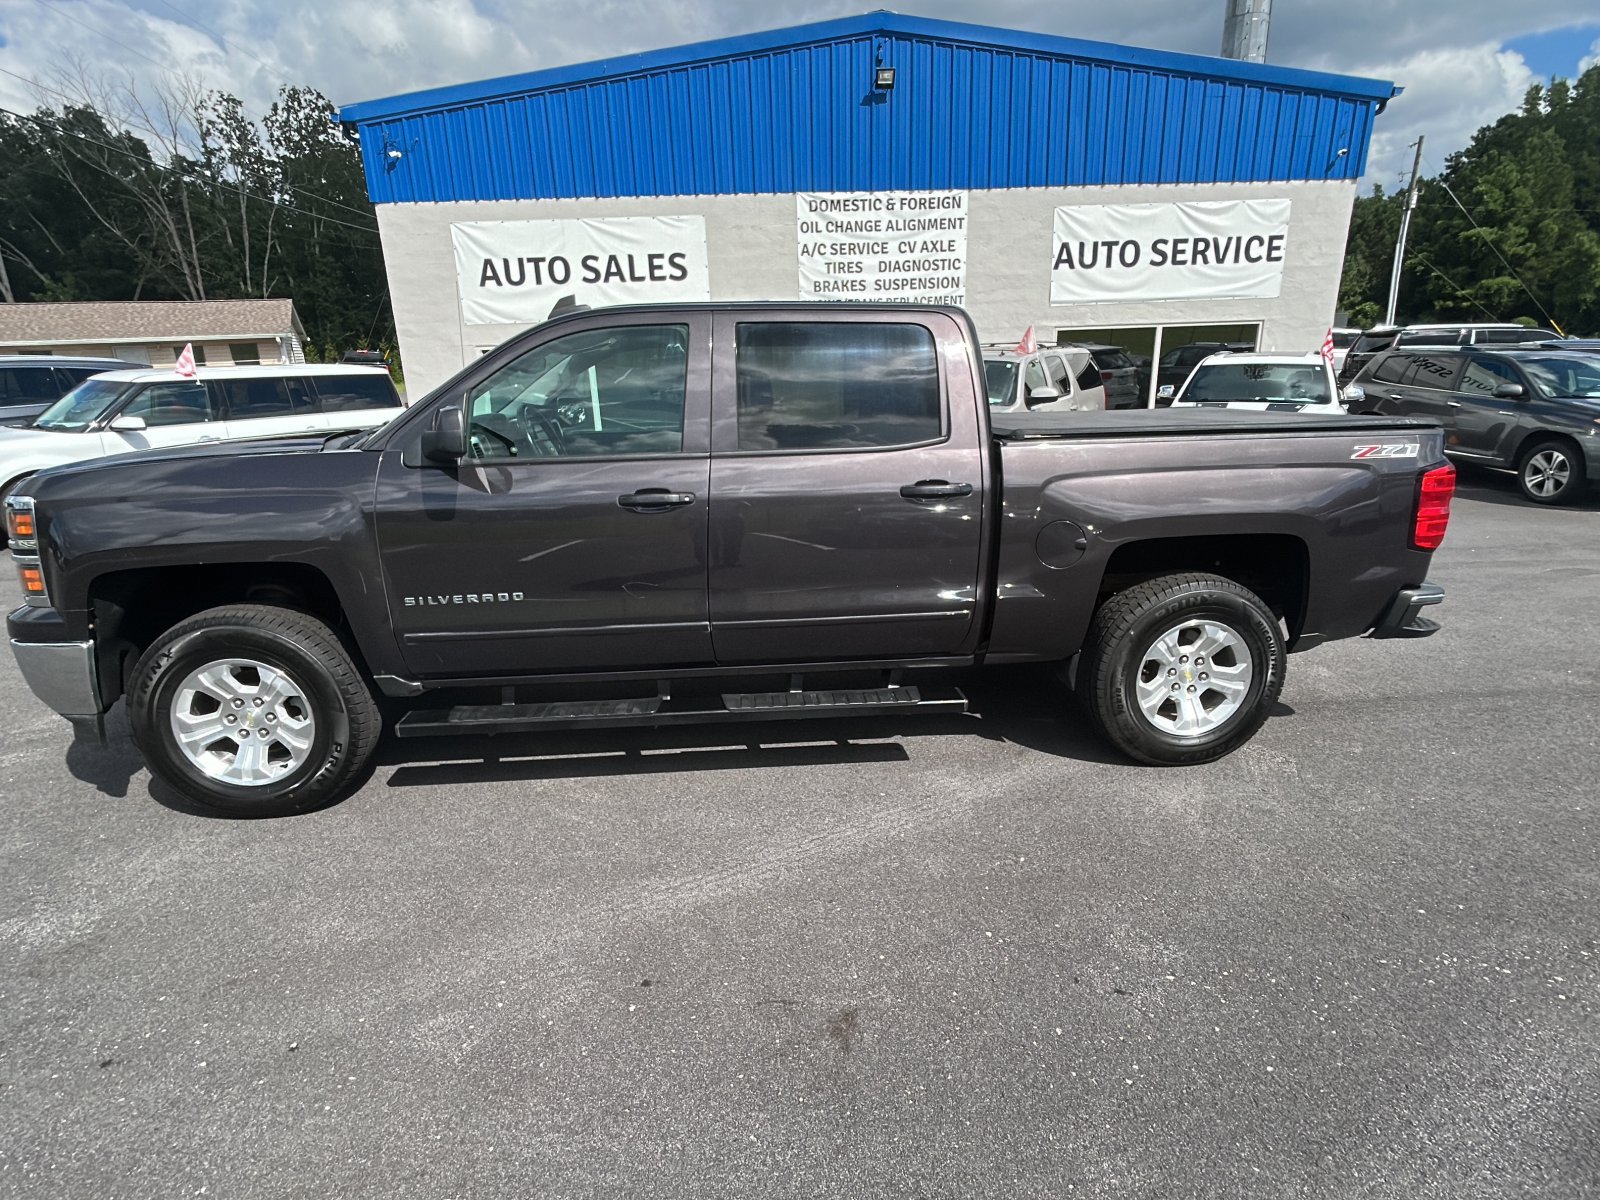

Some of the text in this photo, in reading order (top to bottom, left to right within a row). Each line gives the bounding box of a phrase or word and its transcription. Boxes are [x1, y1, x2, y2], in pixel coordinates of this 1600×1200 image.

[809, 196, 962, 213] DOMESTIC & FOREIGN
[800, 217, 965, 234] OIL CHANGE ALIGNMENT
[801, 240, 956, 257] A/C SERVICE CV AXLE
[1053, 234, 1284, 270] AUTO SERVICE
[479, 252, 688, 287] AUTO SALES
[825, 258, 961, 274] TIRES DIAGNOSTIC
[813, 276, 960, 292] BRAKES SUSPENSION
[1350, 444, 1420, 459] Z71
[404, 592, 524, 606] SILVERADO
